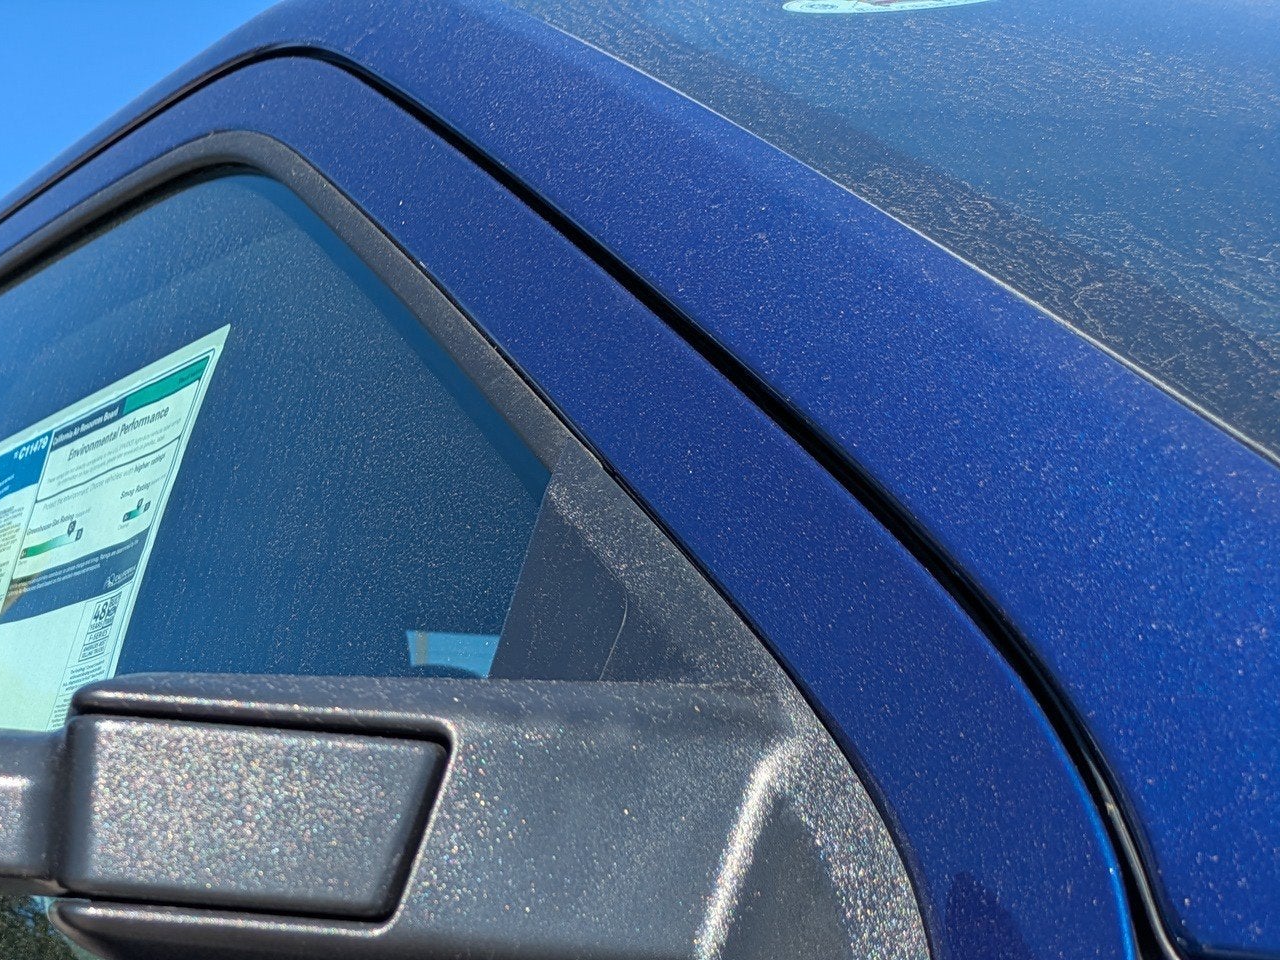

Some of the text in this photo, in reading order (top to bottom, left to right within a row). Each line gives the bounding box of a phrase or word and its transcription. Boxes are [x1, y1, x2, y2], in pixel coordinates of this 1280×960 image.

[104, 406, 119, 422] Board
[67, 426, 121, 461] Environmental
[119, 406, 170, 437] Performance
[93, 602, 108, 621] 48
